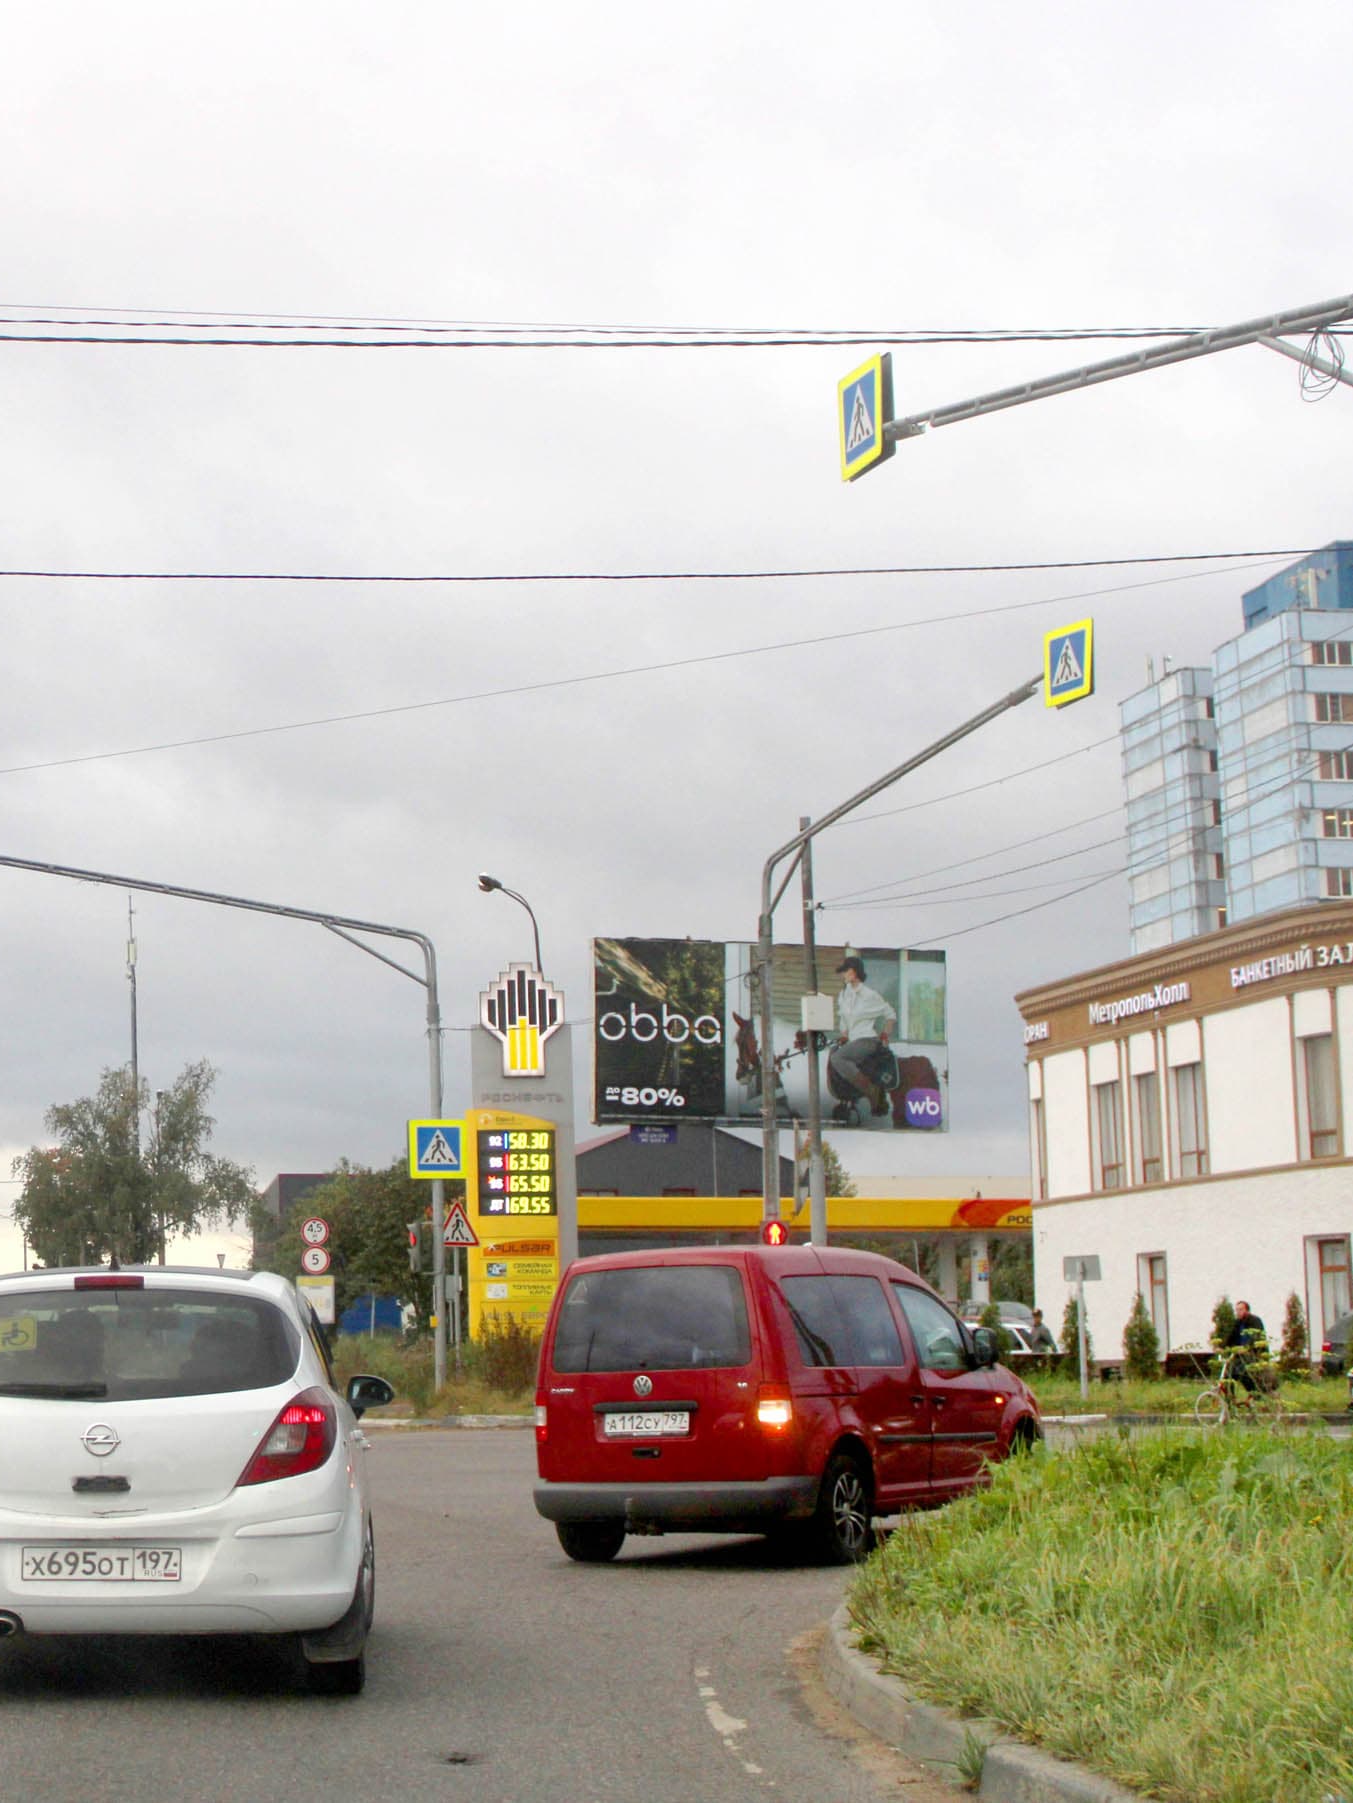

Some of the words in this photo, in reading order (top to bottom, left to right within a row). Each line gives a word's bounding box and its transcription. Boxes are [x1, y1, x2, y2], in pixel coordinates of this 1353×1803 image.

[1230, 944, 1313, 988] БАНКЕТНЫЙ
[1089, 982, 1191, 1025] МетропольХолл
[600, 1002, 721, 1043] obba
[908, 1096, 940, 1115] wb
[312, 1254, 320, 1265] 5
[609, 1415, 659, 1430] А112СУ
[664, 1413, 684, 1425] 797
[31, 1551, 129, 1576] Х695ОТ
[136, 1551, 174, 1570] 197
